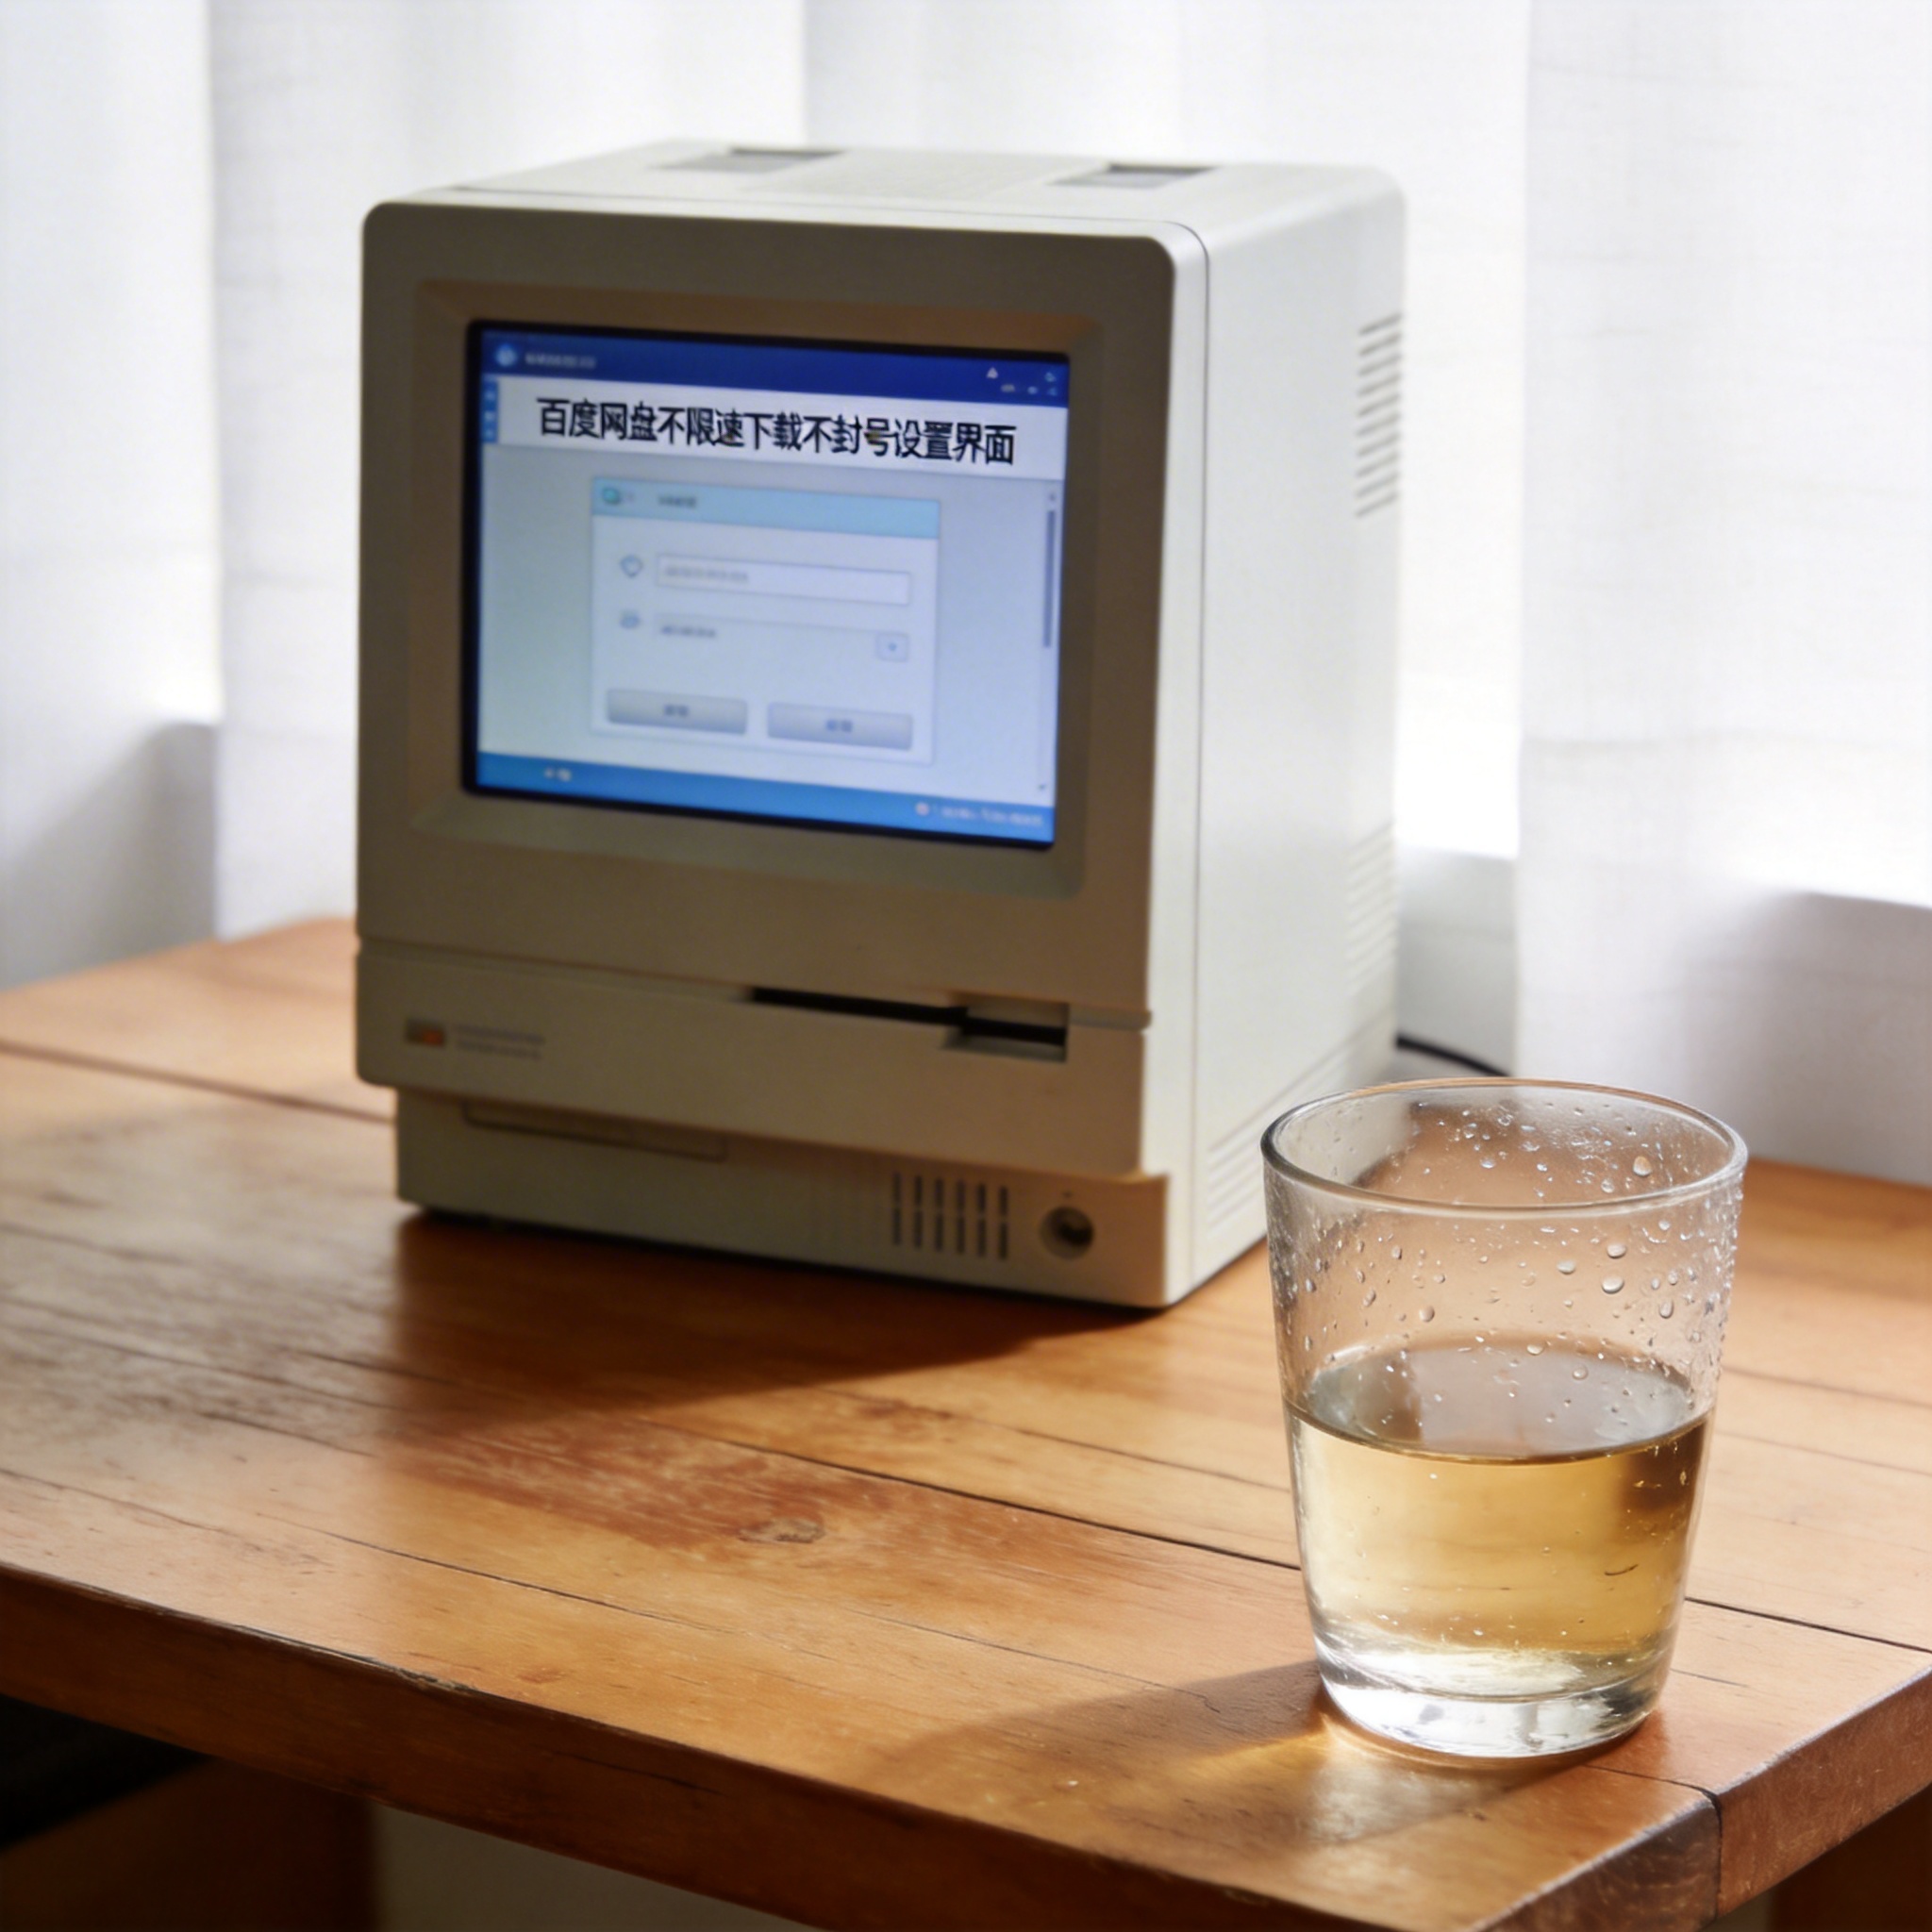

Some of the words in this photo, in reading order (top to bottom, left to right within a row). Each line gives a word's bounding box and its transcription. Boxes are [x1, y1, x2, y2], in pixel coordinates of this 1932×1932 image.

[536, 397, 1016, 465] 百度网盘不限速下载不封号设置界面
